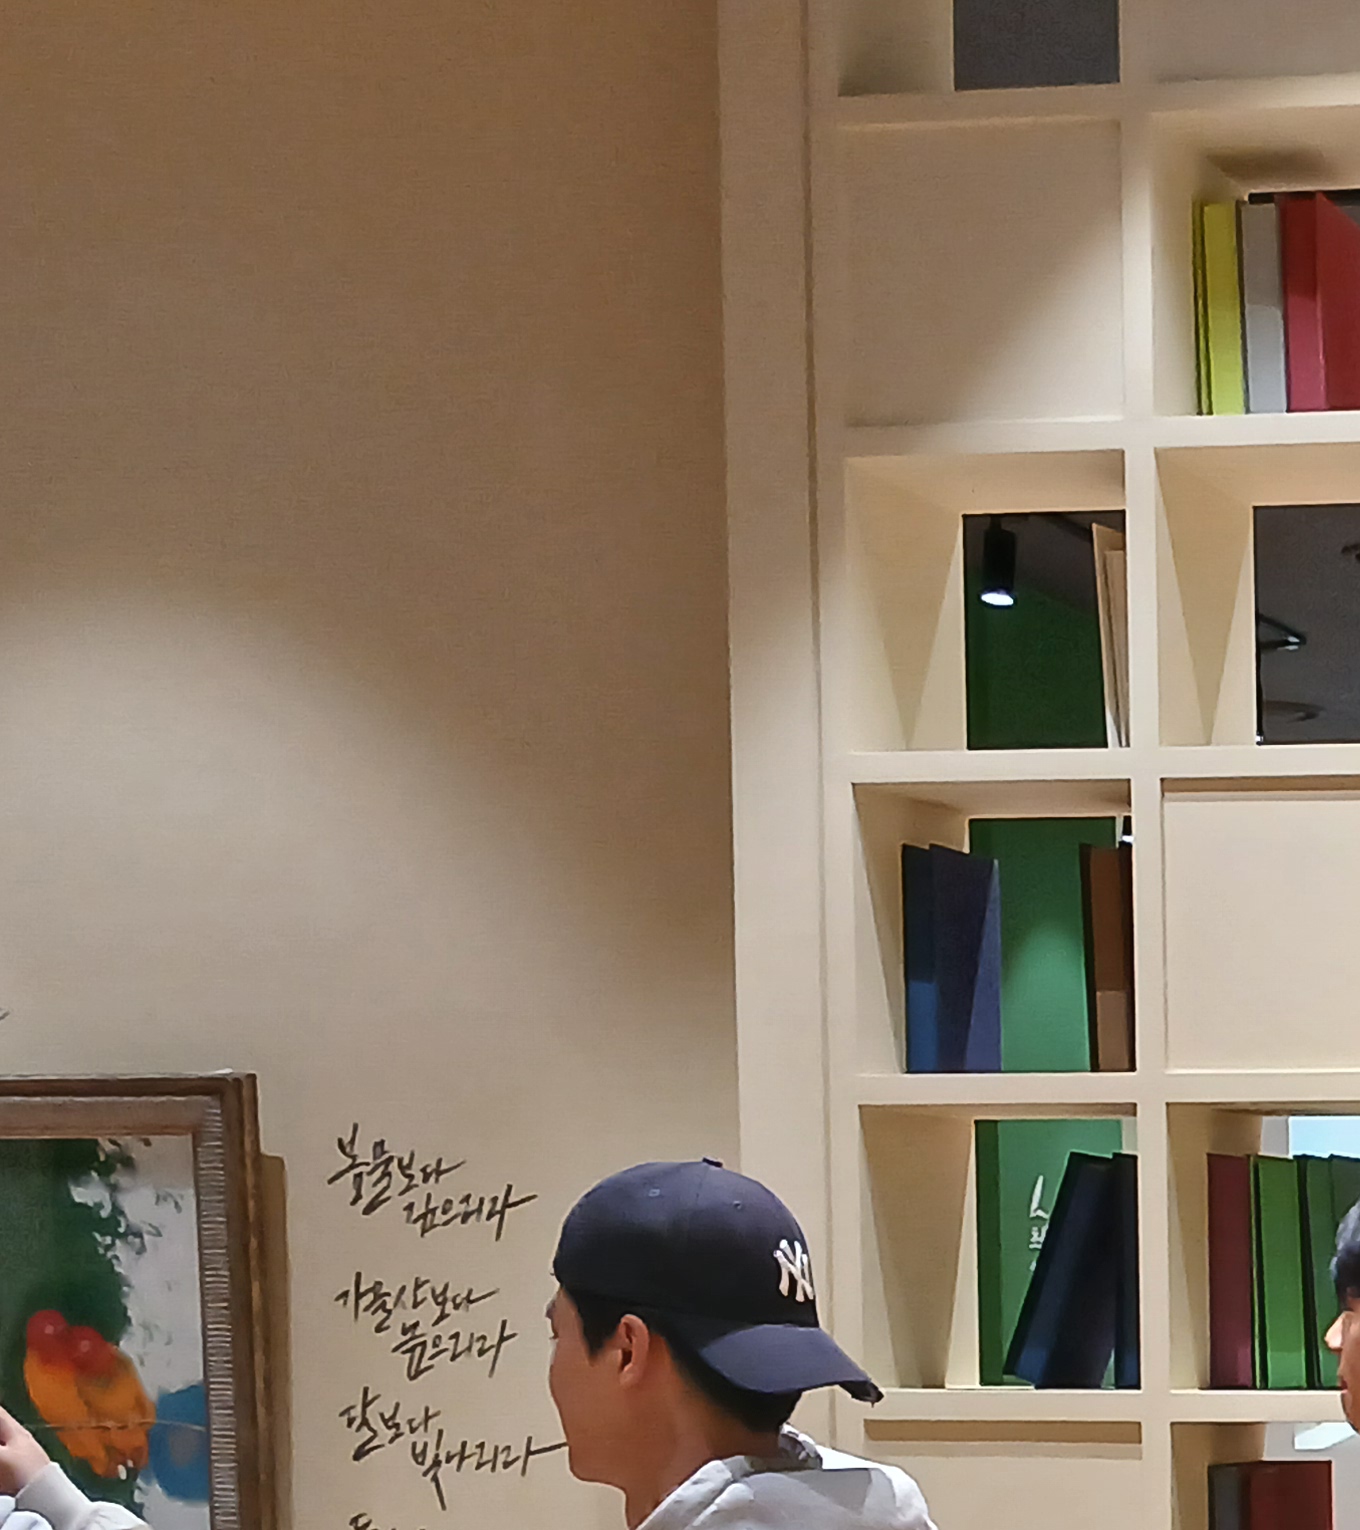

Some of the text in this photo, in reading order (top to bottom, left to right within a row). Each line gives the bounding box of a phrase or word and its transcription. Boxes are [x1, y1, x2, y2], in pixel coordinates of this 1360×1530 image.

[773, 1239, 814, 1302] NY
[391, 1319, 518, 1381] 높으리라
[339, 1386, 441, 1461] 달보다
[411, 1429, 569, 1511] 빛나리라
